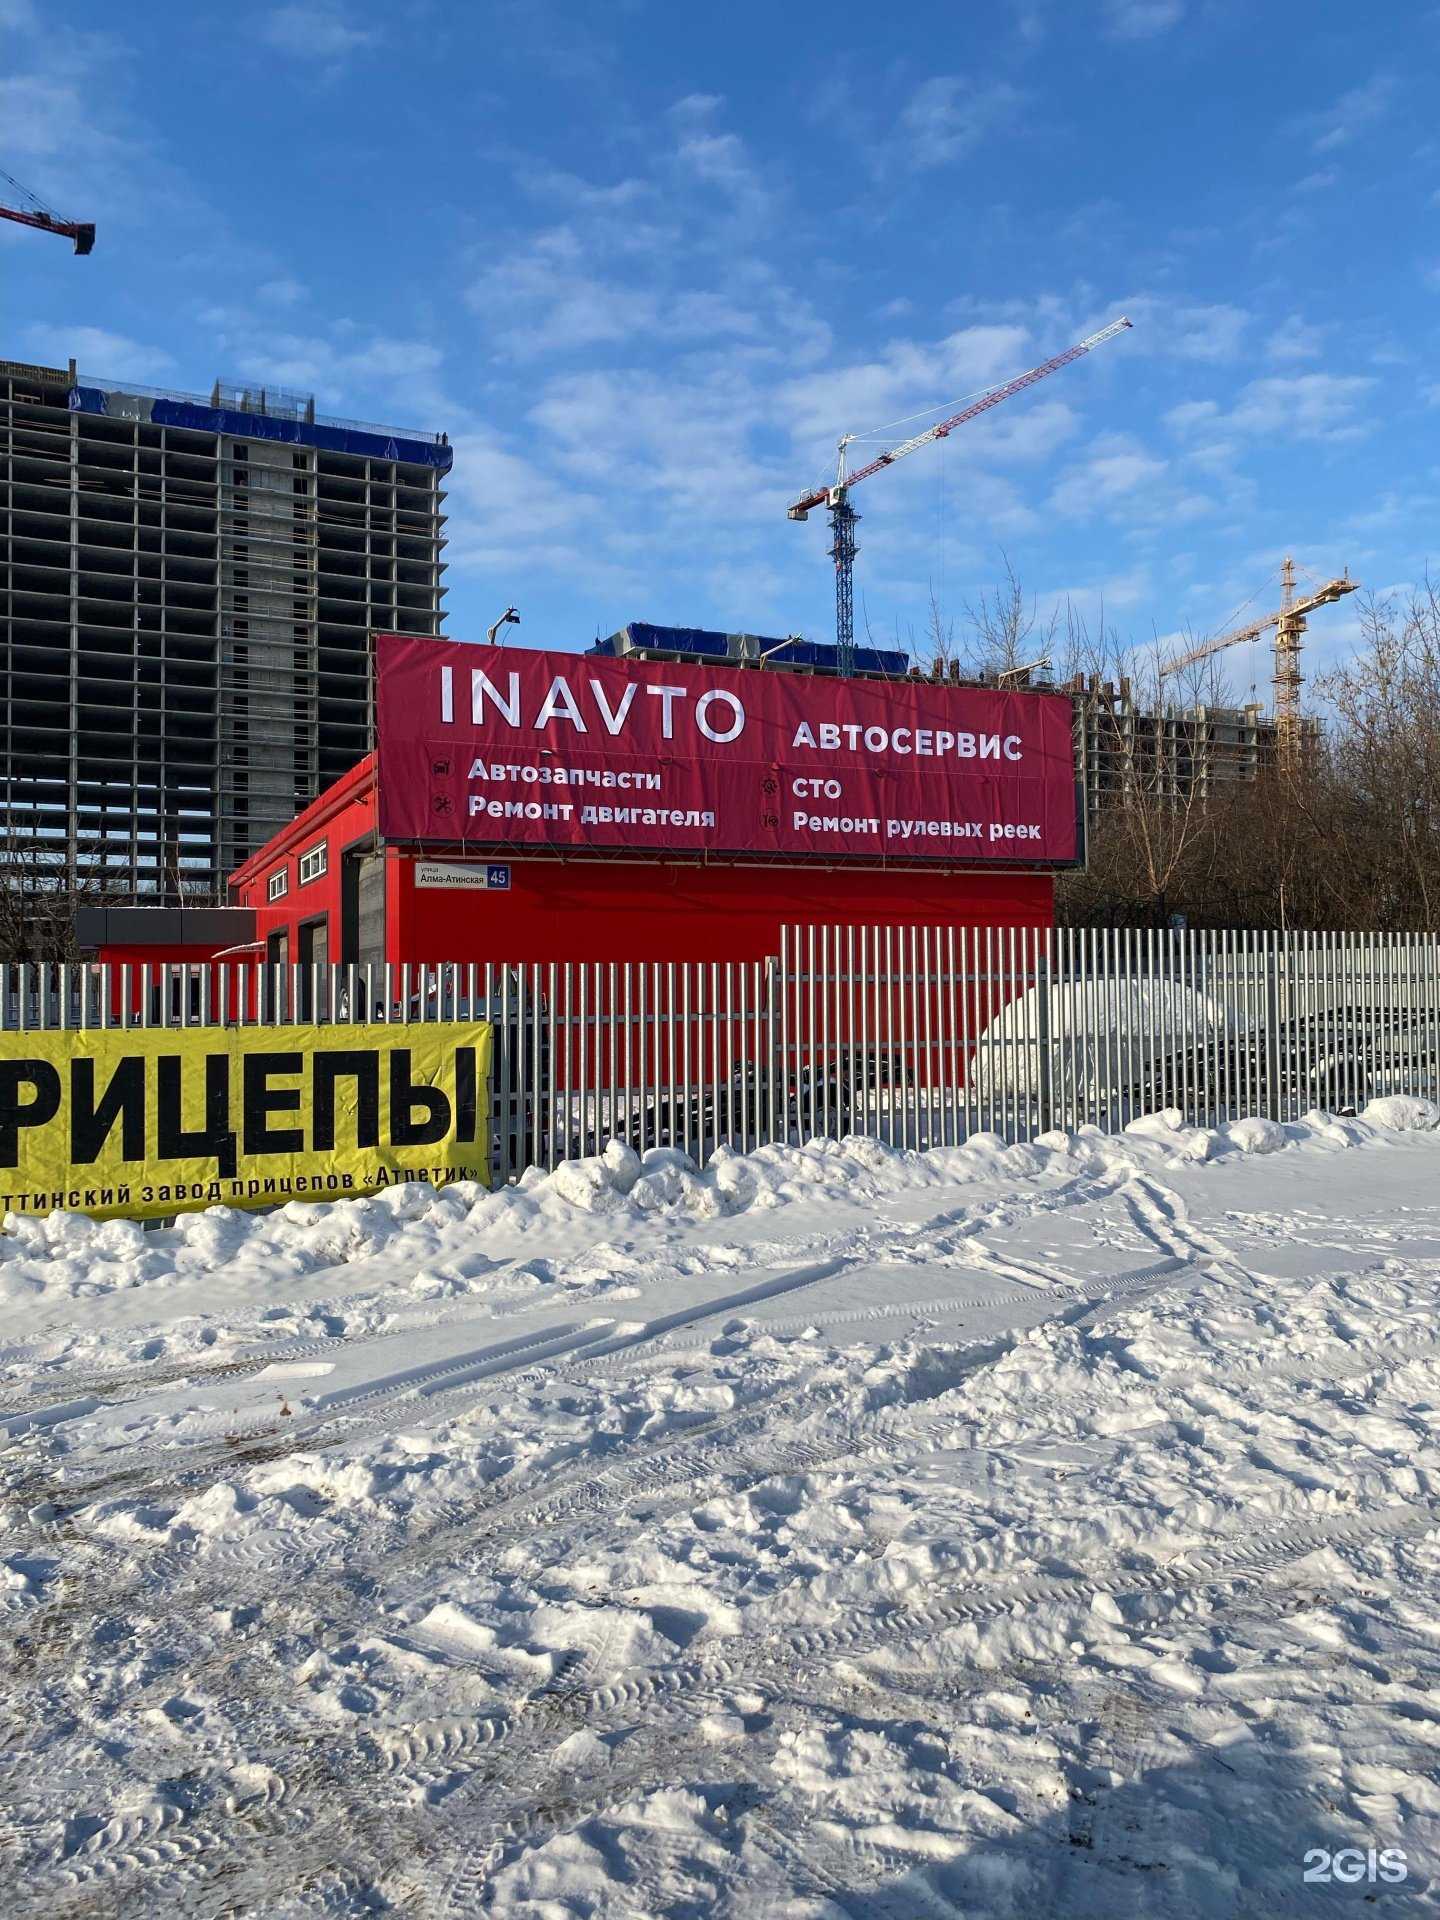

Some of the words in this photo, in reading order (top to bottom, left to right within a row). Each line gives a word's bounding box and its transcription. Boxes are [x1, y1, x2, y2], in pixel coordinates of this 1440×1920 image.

[440, 666, 746, 744] INAVTO
[792, 721, 1023, 761] АВТОСЕРВИС
[467, 759, 661, 790] Автозапчасти
[792, 778, 842, 800] СТО
[468, 795, 574, 821] Ремонт
[580, 805, 716, 828] двигателя
[792, 811, 881, 834] Ремонт
[886, 818, 983, 839] рулевых
[989, 823, 1042, 841] реек
[420, 874, 484, 884] Алма-Атинская
[490, 870, 506, 884] 45
[0, 1047, 476, 1178] РИЦЕПЫ
[142, 1180, 222, 1201] завод
[232, 1174, 353, 1198] прицепов
